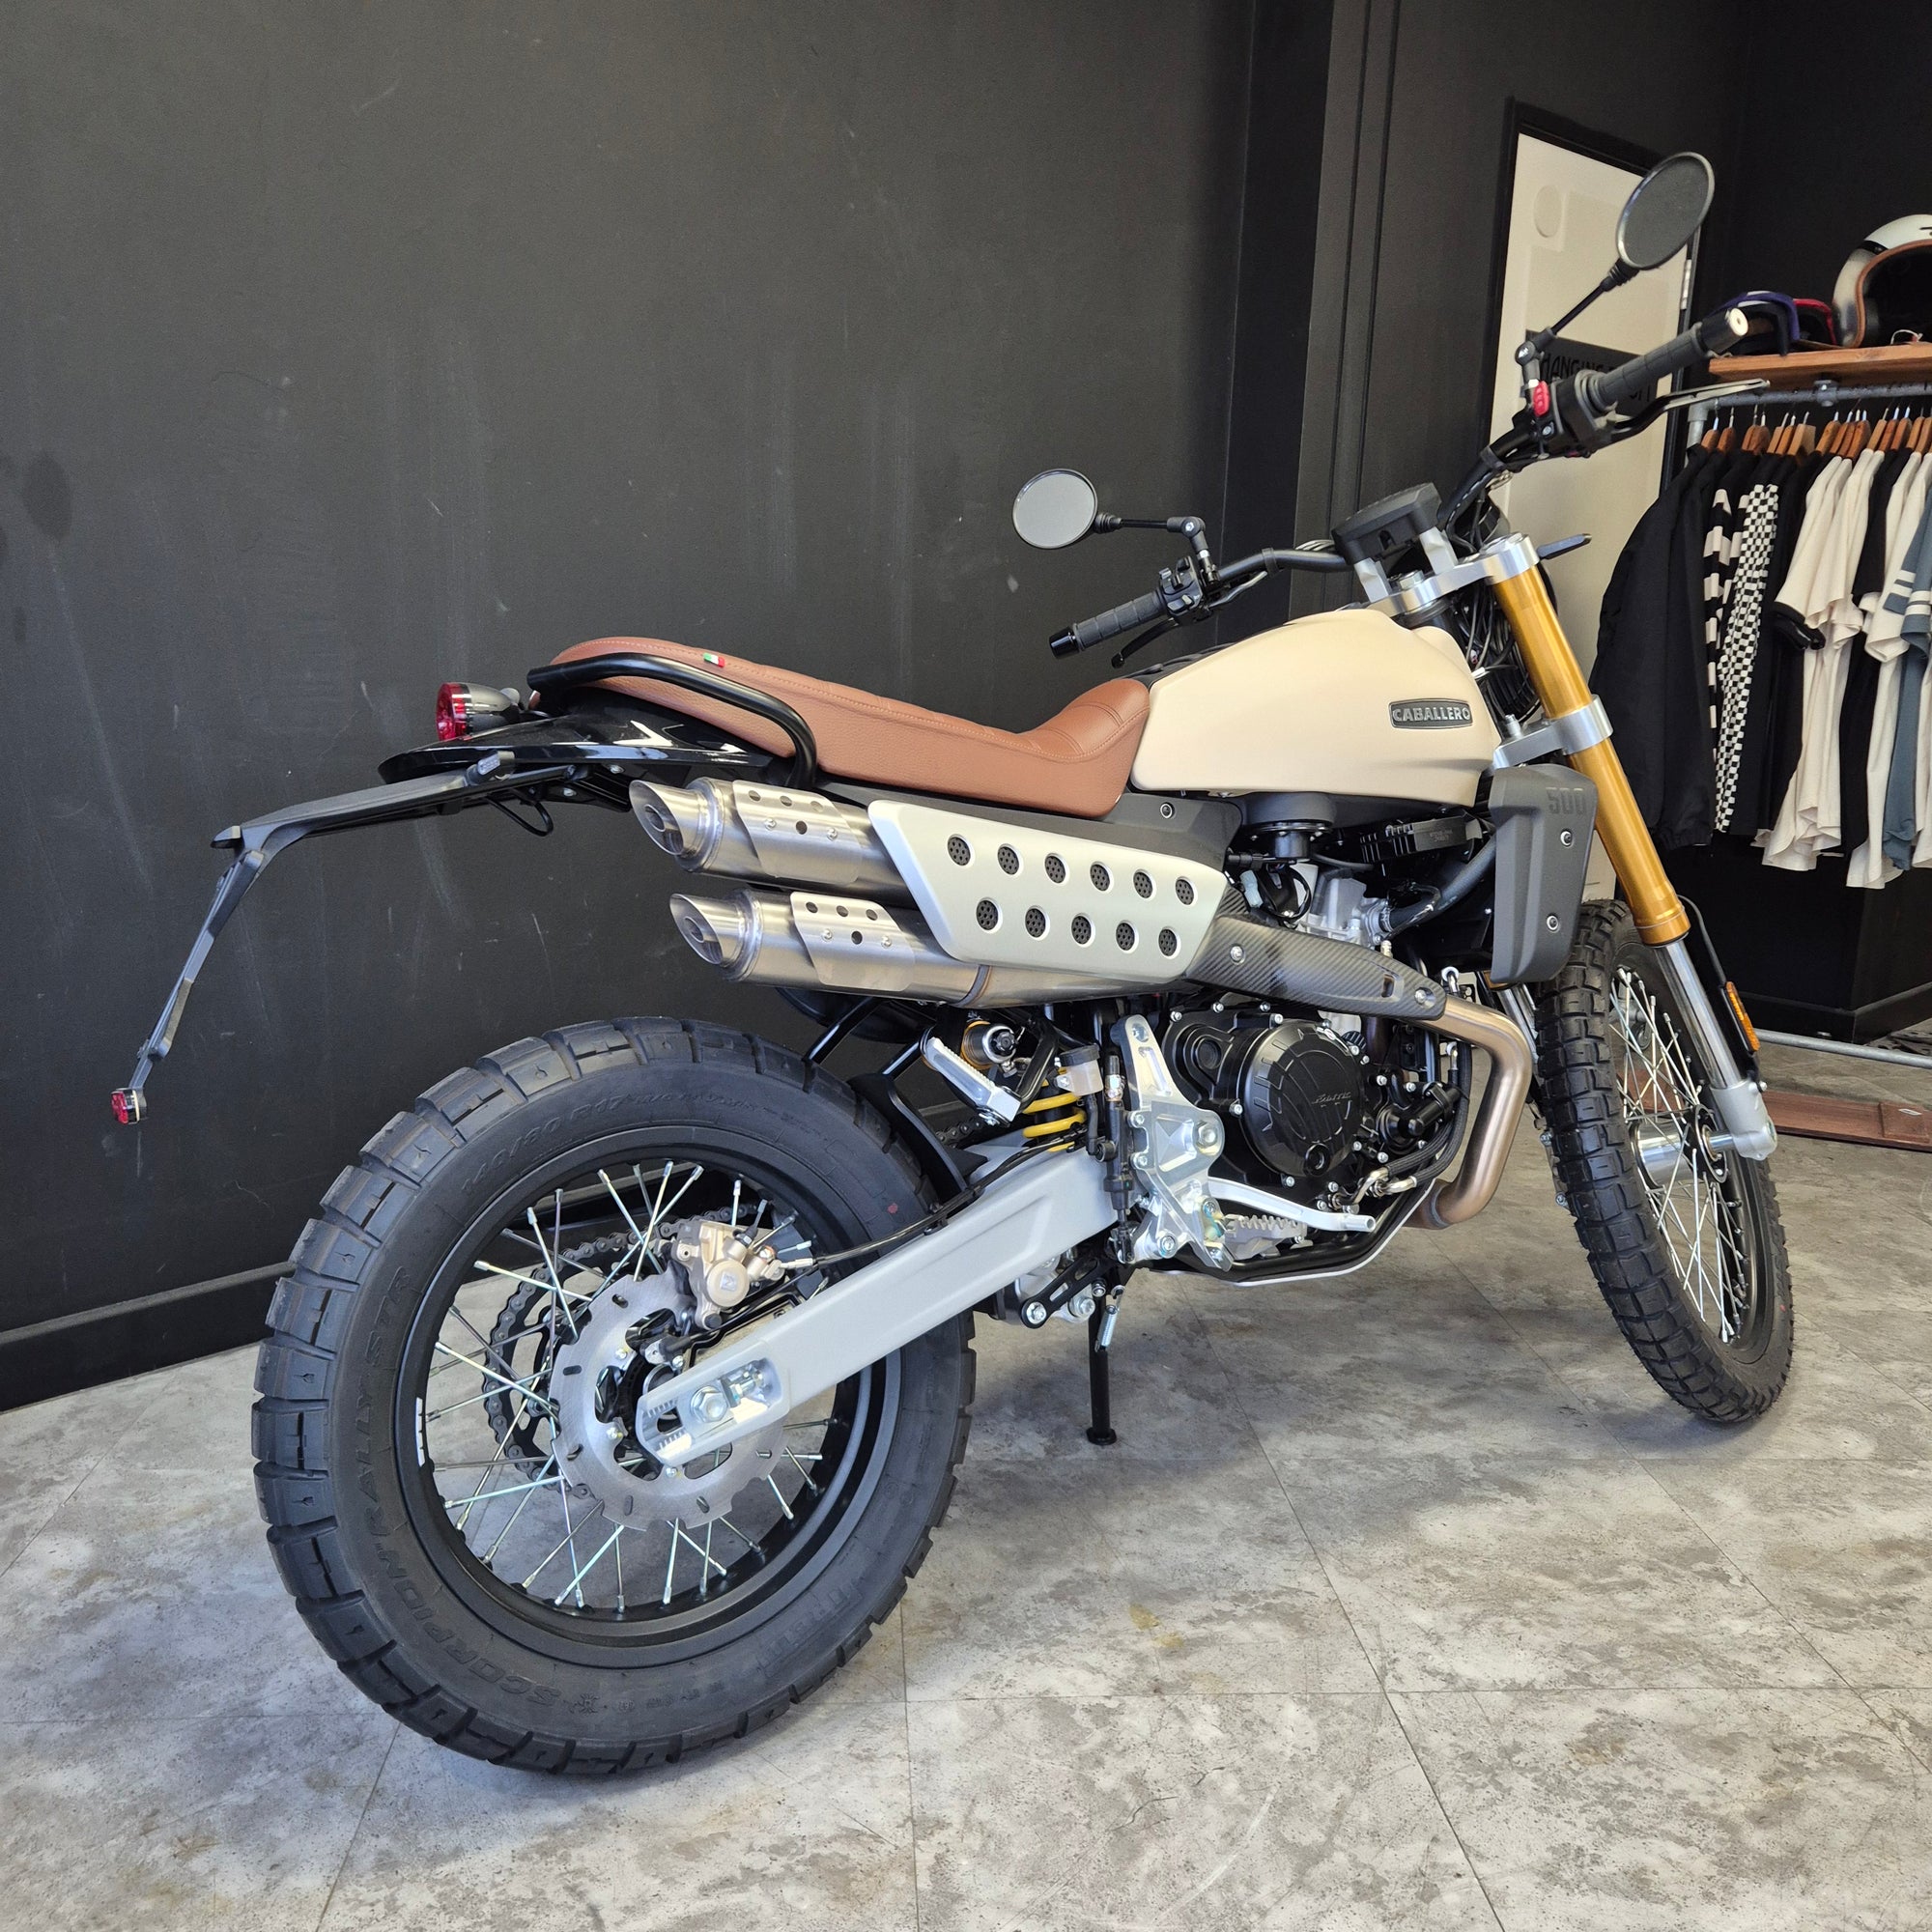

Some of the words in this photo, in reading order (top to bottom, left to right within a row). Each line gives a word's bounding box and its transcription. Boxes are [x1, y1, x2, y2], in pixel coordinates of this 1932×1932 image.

[1392, 706, 1471, 722] CABALLERO
[1547, 786, 1587, 815] 500
[375, 1546, 562, 1709] SCORPION
